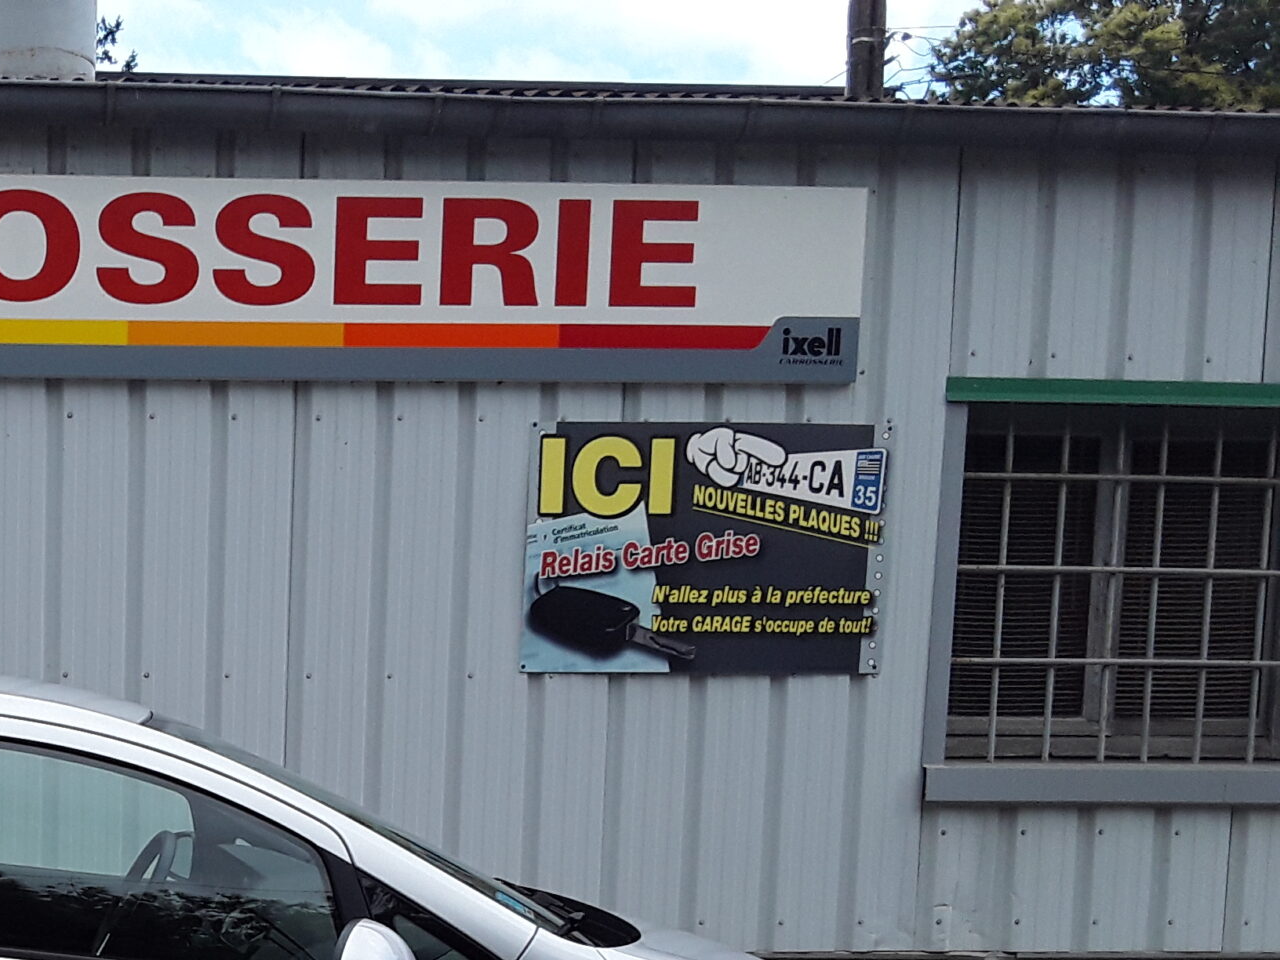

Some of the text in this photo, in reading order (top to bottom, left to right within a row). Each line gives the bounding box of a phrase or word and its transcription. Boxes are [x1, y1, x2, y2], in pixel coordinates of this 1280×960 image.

[782, 327, 841, 357] ixell
[538, 434, 677, 517] ICI
[746, 460, 845, 498] AB-344-CA
[854, 485, 877, 506] 35
[693, 484, 785, 522] NOUVELLES
[789, 504, 860, 538] PLAQUES
[552, 523, 587, 535] Certificat
[553, 525, 619, 544] d'immatriculation
[540, 530, 760, 578] Relais Carte Grise
[652, 585, 871, 607] N'allez plus à la préfecture
[651, 615, 872, 636] Votre GARAGE s'occupe de tout!
